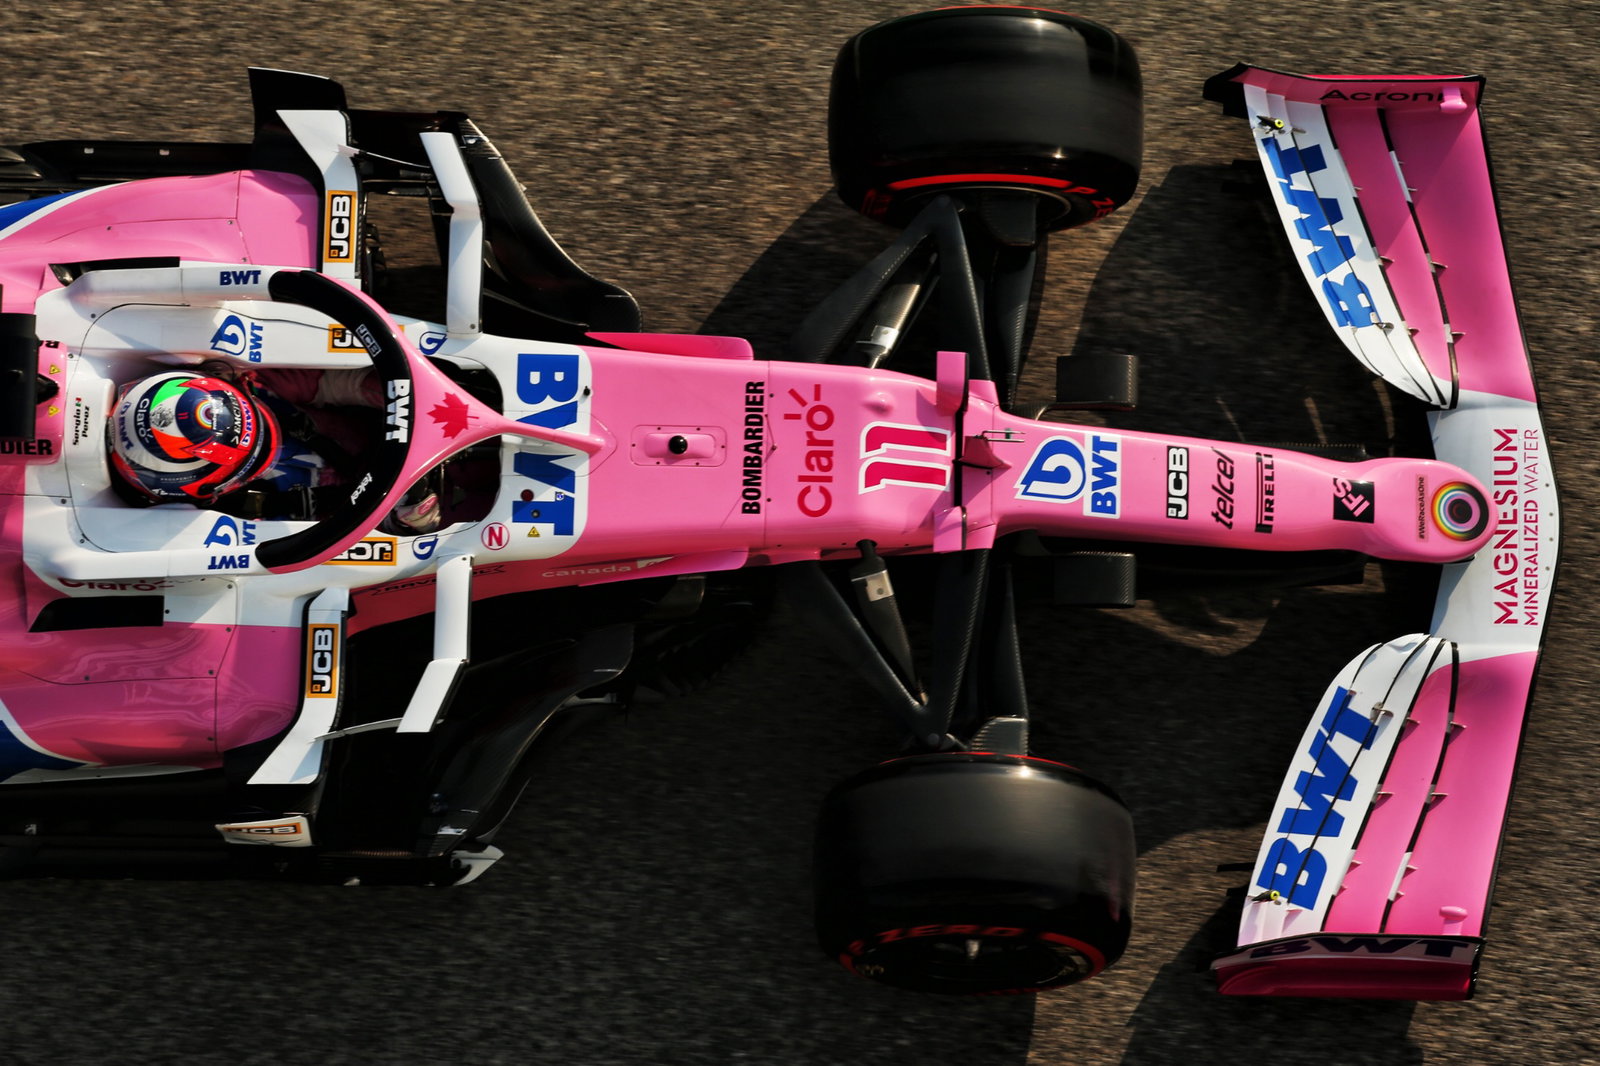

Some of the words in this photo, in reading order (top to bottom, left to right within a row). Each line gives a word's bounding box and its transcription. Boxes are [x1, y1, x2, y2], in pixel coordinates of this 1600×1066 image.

[330, 195, 350, 258] JCB
[1261, 137, 1382, 328] BWT
[219, 270, 262, 286] BWT
[249, 322, 264, 363] BWT
[357, 325, 381, 356] JCB
[72, 408, 81, 446] Sergio
[119, 418, 135, 451] BWT
[136, 398, 151, 441] Claro
[241, 399, 253, 432] BWT
[385, 379, 410, 443] BWT
[512, 353, 579, 536] BWT
[742, 381, 765, 514] BOMBARDIER
[797, 403, 834, 518] Claro
[858, 421, 951, 495] 11
[1091, 435, 1119, 515] BWT
[1523, 429, 1539, 494] WATER
[351, 472, 373, 505] telcel
[1166, 447, 1188, 518] JCB
[1211, 447, 1235, 530] telcel
[1255, 452, 1274, 534] PIRELLI
[1417, 476, 1426, 540] #WeRaceAsOne
[242, 521, 256, 545] WT
[488, 526, 503, 547] N
[1493, 428, 1518, 625] MAGNESIUM
[208, 555, 249, 570] BWT
[542, 566, 632, 578] canada
[1523, 499, 1539, 626] MINERALIZED
[312, 629, 333, 692] JCB
[233, 826, 296, 834] JCB
[1256, 686, 1379, 911] BWT
[875, 924, 1026, 944] ZERO
[1250, 937, 1469, 958] BWT
